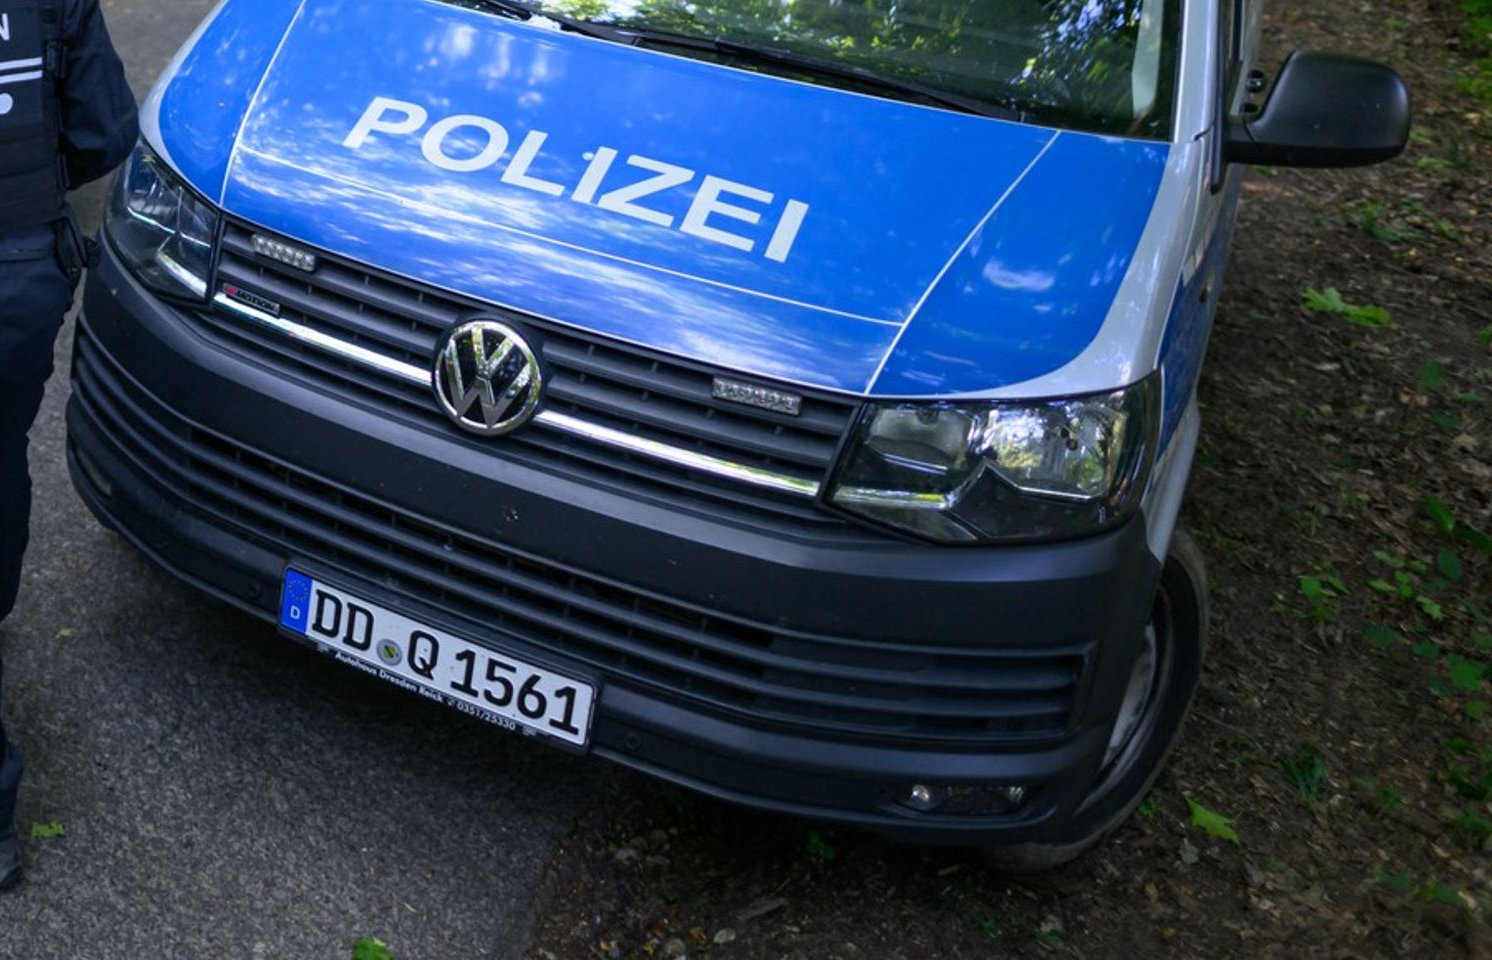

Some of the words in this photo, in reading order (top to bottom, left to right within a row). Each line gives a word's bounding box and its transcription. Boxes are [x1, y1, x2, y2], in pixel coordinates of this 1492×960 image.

[342, 96, 809, 263] POLIZEI
[435, 321, 541, 435] VW
[289, 604, 301, 620] D
[312, 588, 374, 651] DD
[407, 630, 439, 680] Q
[450, 649, 580, 736] 1561
